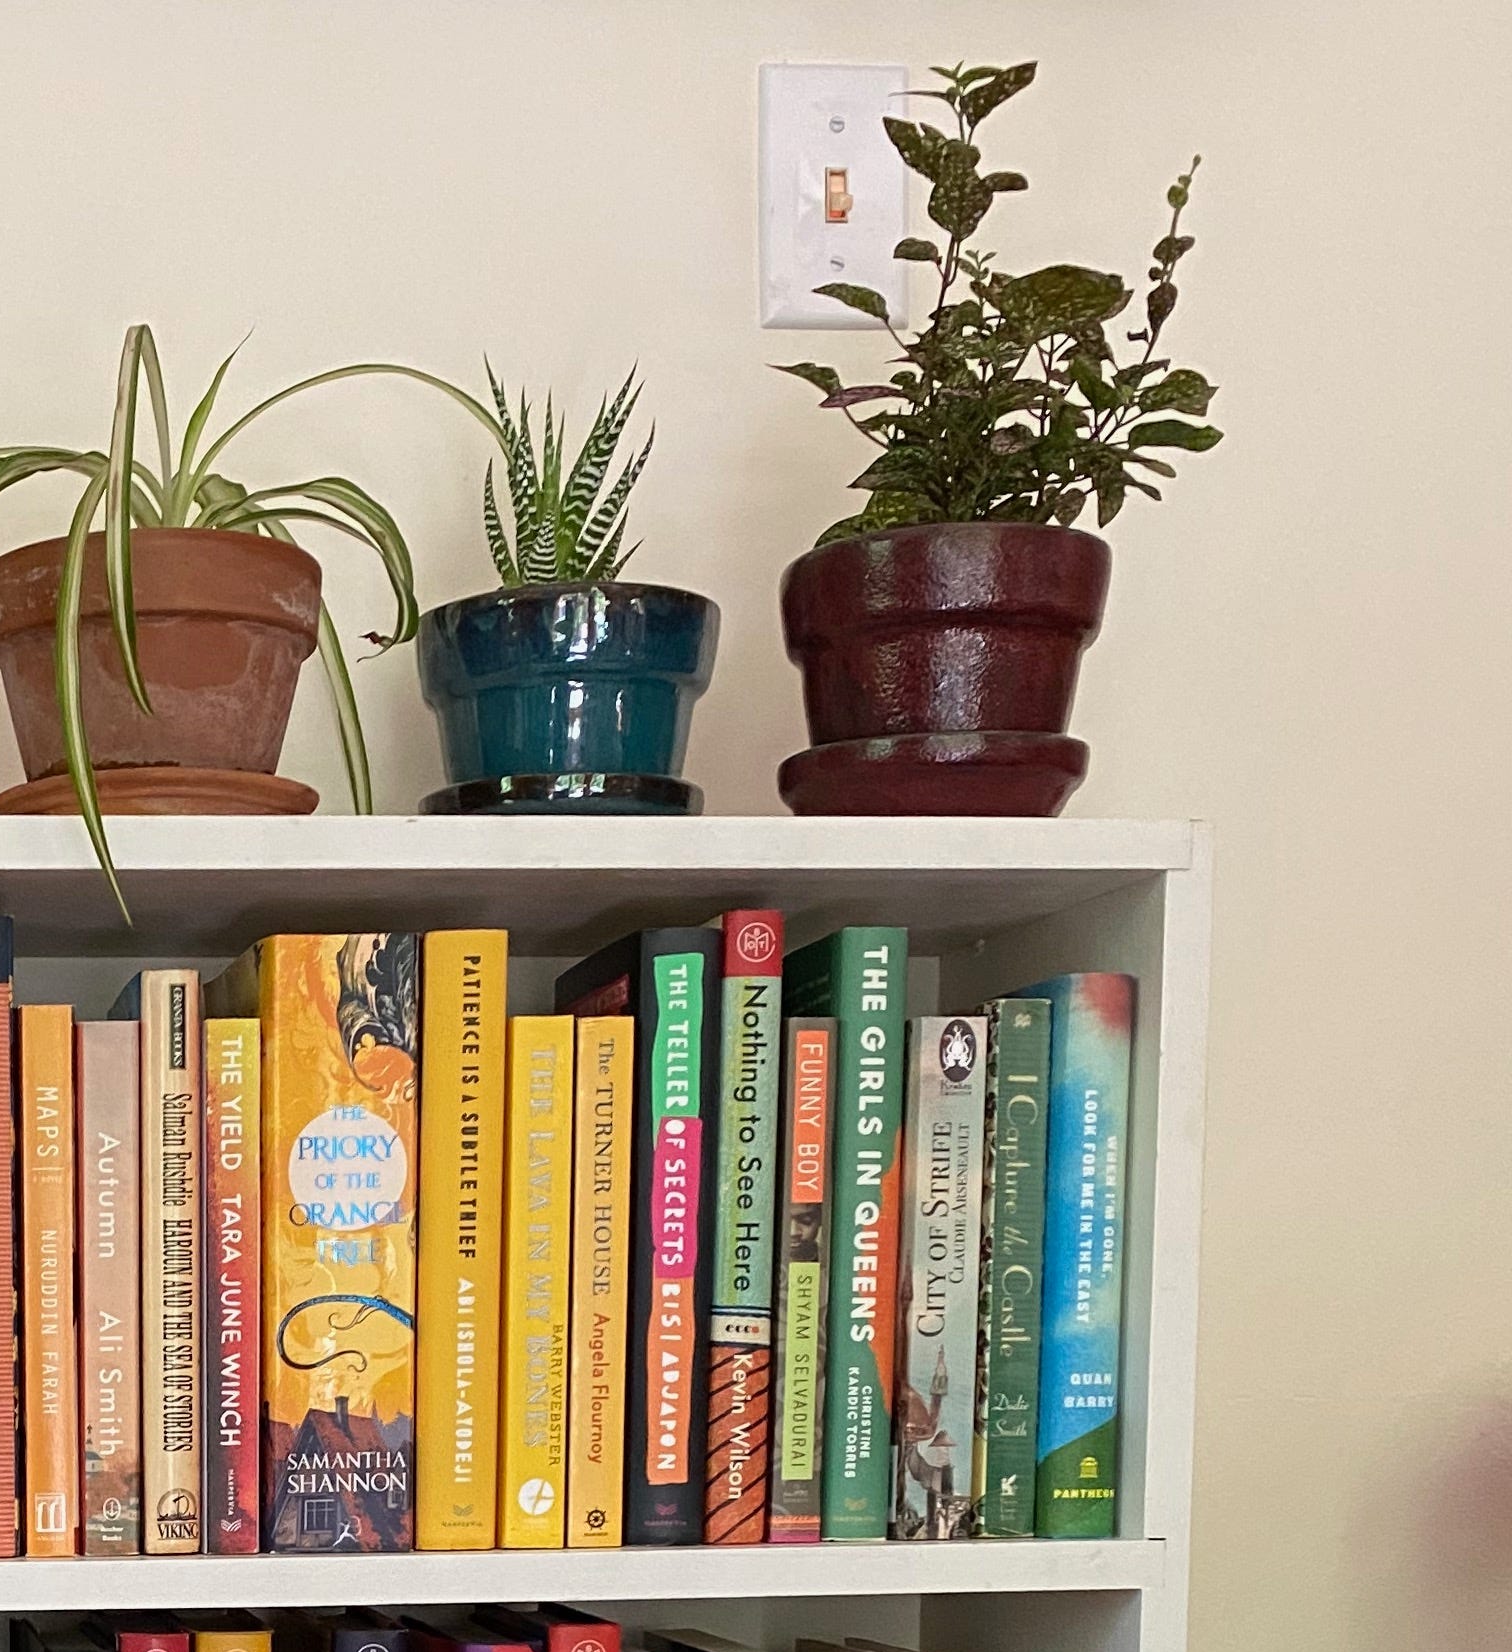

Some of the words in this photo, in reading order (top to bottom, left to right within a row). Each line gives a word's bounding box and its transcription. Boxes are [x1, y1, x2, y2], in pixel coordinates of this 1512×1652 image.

[462, 956, 481, 1055] PATIENCE
[734, 985, 768, 1099] Nothing
[461, 1066, 479, 1084] IS
[461, 1094, 478, 1103] A
[800, 1042, 822, 1127] FUNNY
[36, 1086, 59, 1158] MAPS
[740, 1115, 759, 1144] to
[461, 1113, 479, 1190] SUBTLE
[798, 1144, 822, 1190] BOY
[98, 1132, 121, 1258] Autumn
[738, 1156, 761, 1210] See
[459, 1197, 475, 1258] THIEF
[737, 1223, 757, 1292] Here
[100, 1311, 121, 1352] Ali
[797, 1274, 813, 1339] SHYAM
[1064, 1396, 1114, 1408] BARRY
[1071, 1373, 1112, 1385] QUAN
[101, 1369, 123, 1456] Smith
[792, 1353, 810, 1467] SELVADURAI
[287, 1452, 406, 1470] SAMANTHA
[287, 1474, 406, 1494] SHANNON
[157, 1524, 198, 1538] VIKING
